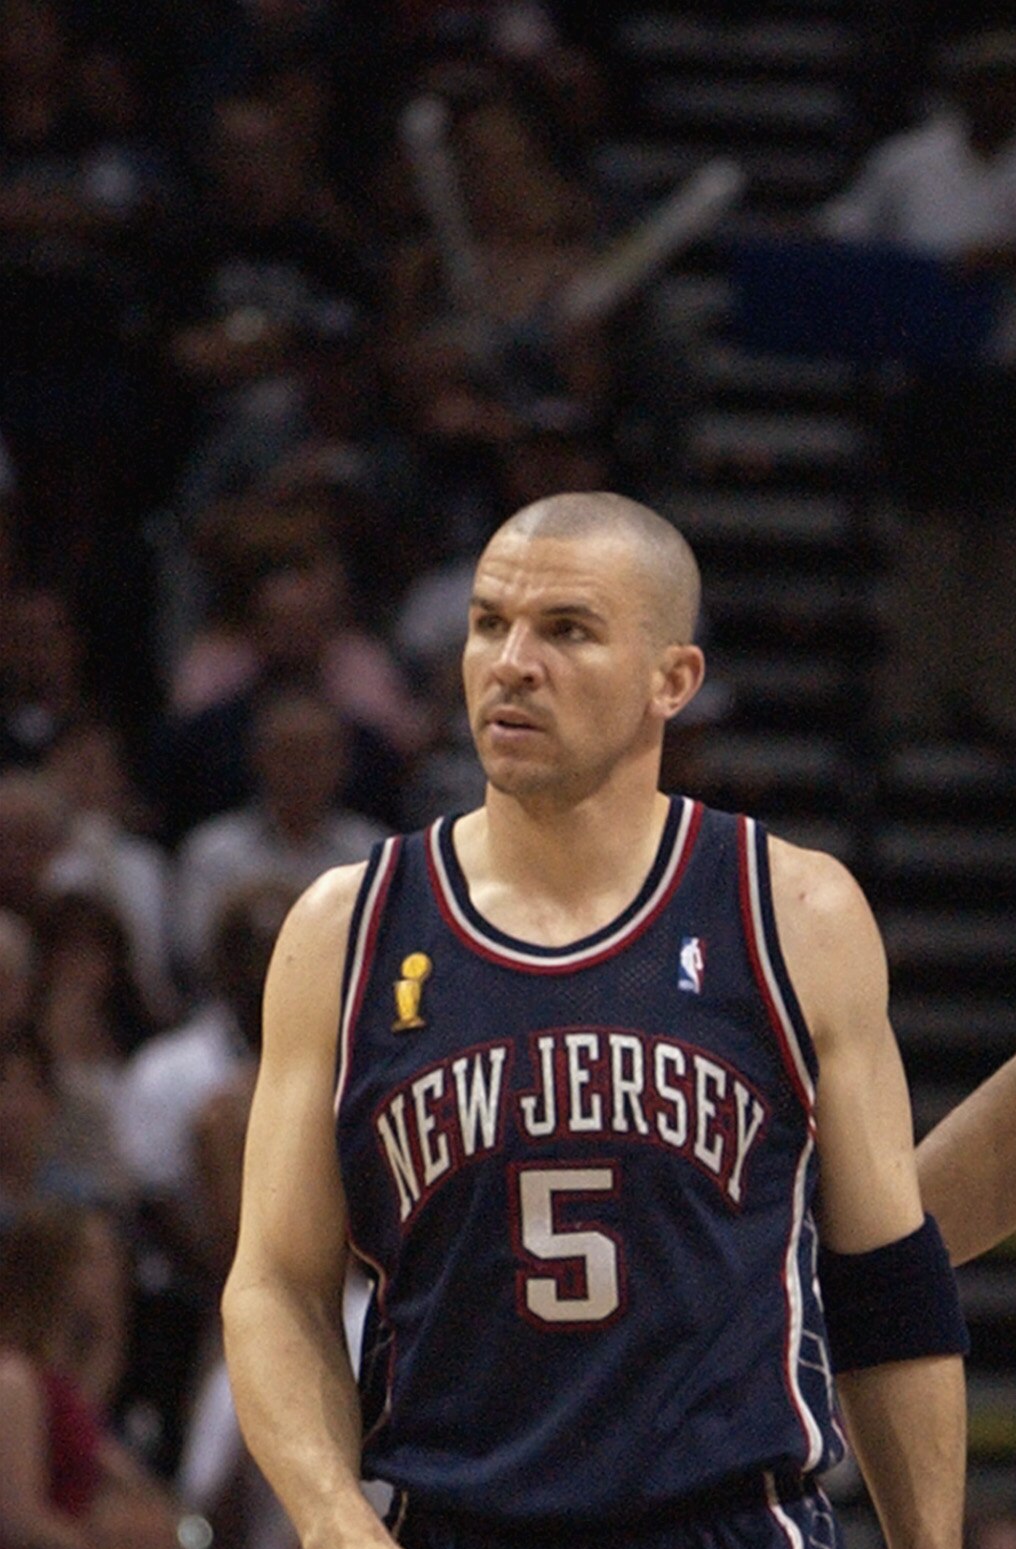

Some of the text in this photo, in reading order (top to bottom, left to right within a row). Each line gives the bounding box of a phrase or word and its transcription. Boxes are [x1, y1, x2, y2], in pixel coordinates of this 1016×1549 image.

[375, 1029, 768, 1227] NEW JERSEY
[515, 1164, 625, 1328] 5
